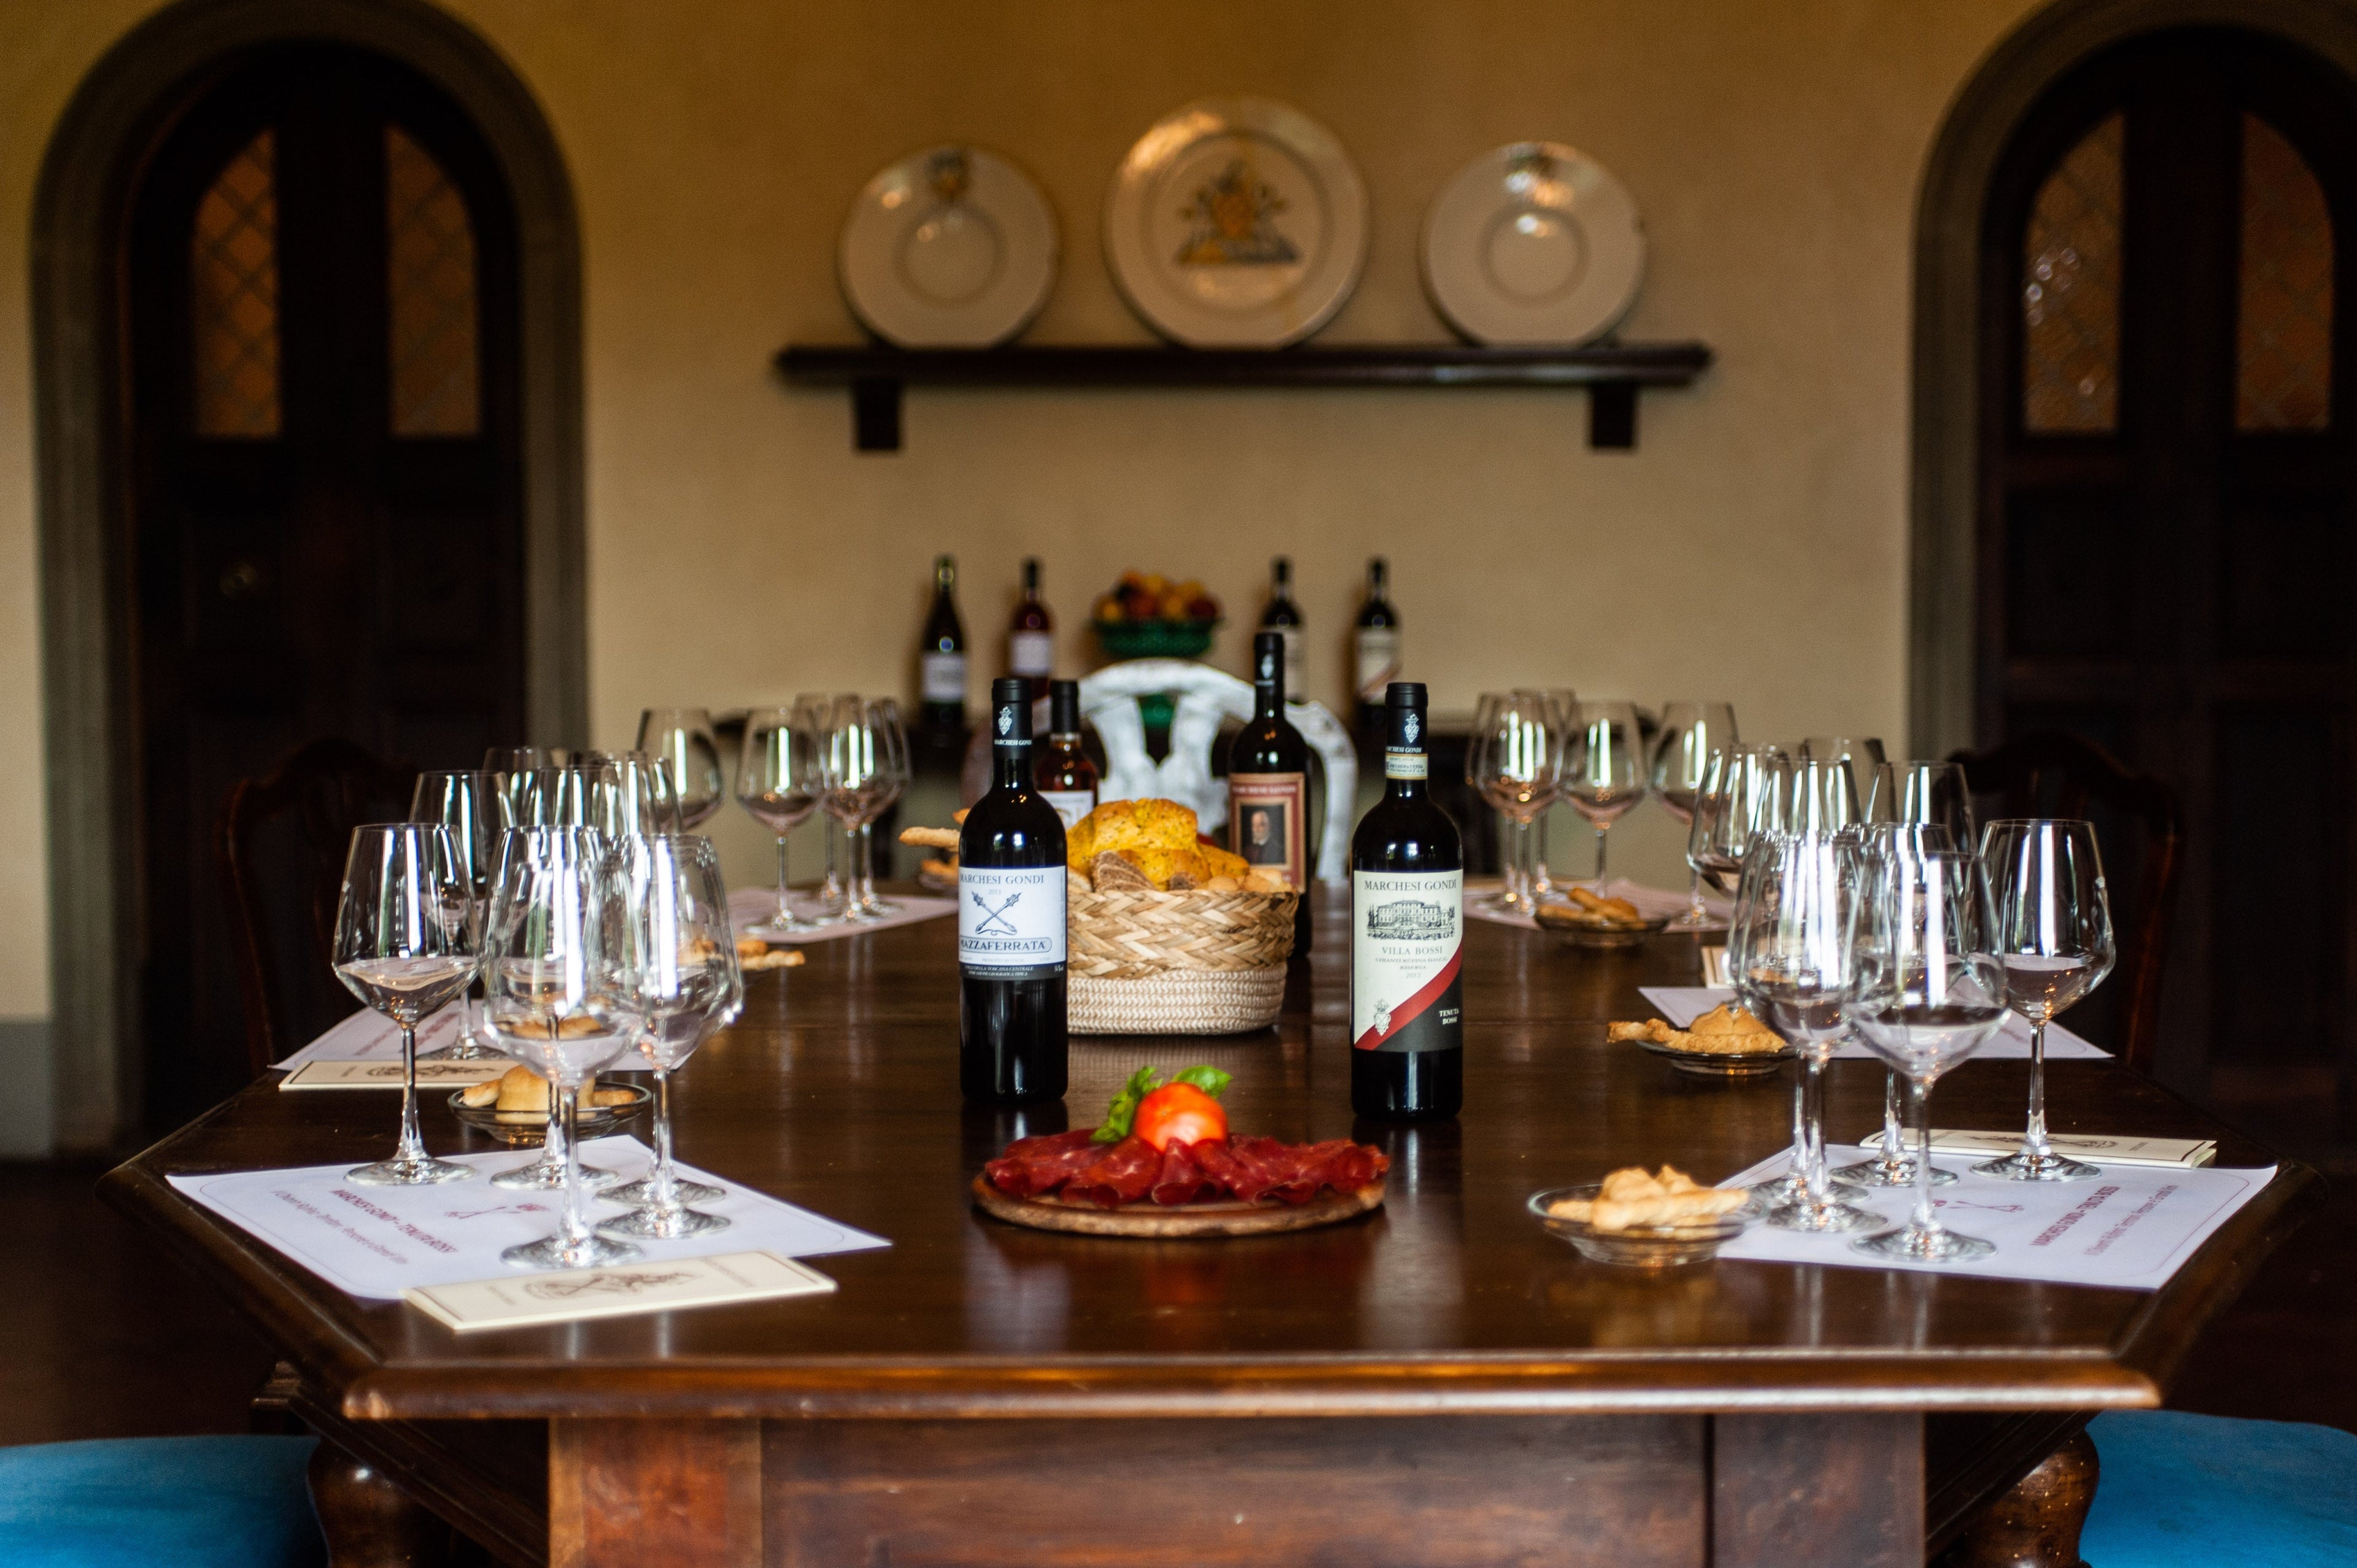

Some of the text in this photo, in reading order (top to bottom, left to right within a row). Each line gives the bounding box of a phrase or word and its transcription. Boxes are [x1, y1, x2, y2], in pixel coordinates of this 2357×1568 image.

[960, 873, 1044, 884] MARCHESI GONDI
[1364, 879, 1457, 890] MARCHESI GONDI
[960, 940, 1046, 951] MAZZAFERRATA
[1415, 946, 1442, 955] BOSSI
